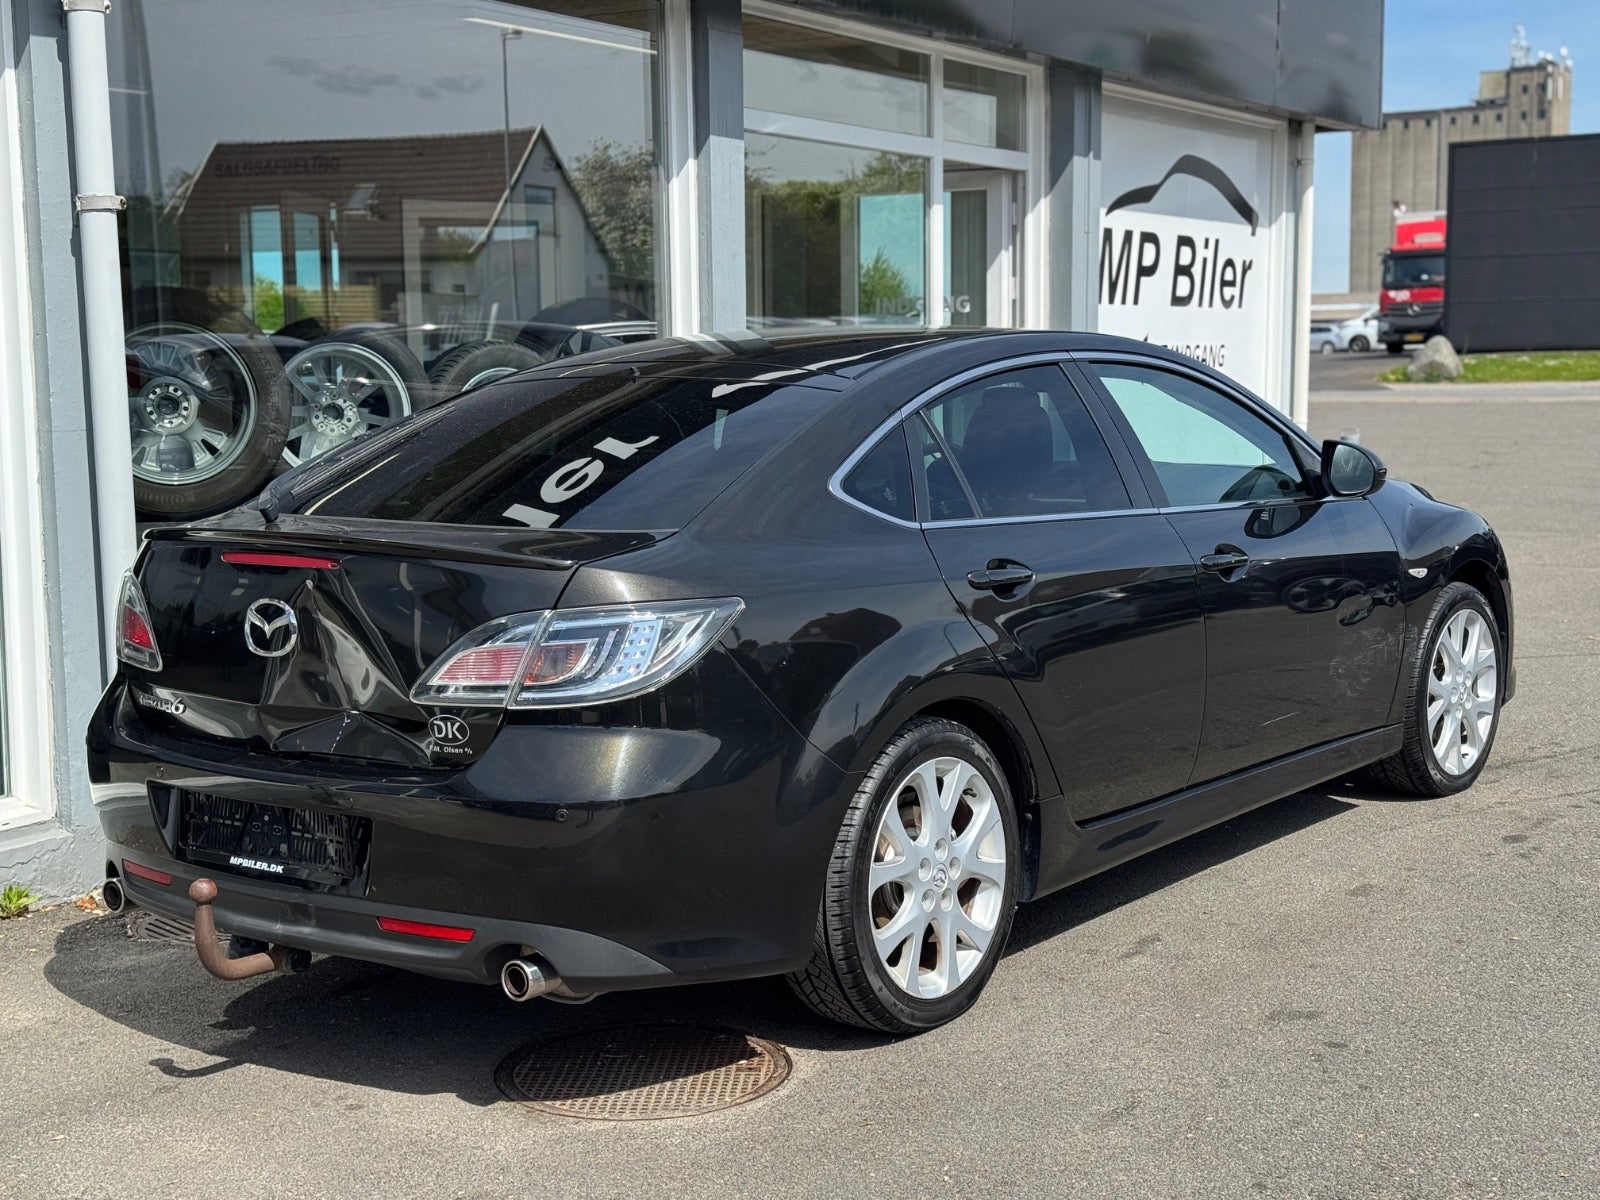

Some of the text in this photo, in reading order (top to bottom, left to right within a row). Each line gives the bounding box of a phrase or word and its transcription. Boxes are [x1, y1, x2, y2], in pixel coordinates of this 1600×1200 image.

[1099, 227, 1253, 310] MP Biler
[1171, 344, 1226, 367] DGANG
[433, 720, 464, 740] DK
[443, 746, 464, 754] Olsen
[229, 856, 285, 874] MPBILER.DK
